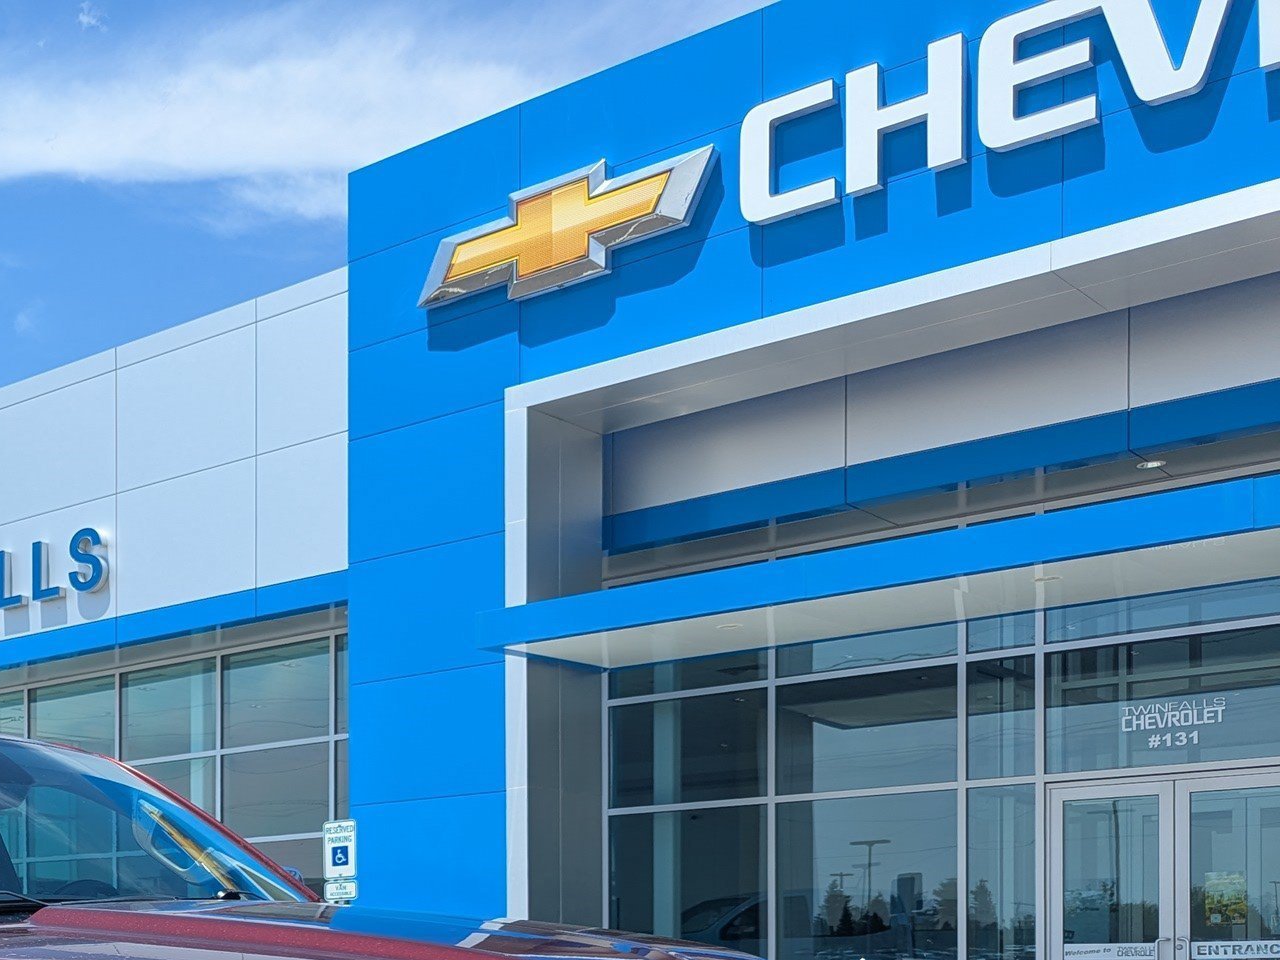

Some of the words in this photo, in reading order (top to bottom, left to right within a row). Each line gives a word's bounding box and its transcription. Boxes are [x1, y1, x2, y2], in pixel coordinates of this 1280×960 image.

[739, 0, 1280, 226] CHEV
[1121, 706, 1226, 732] CHEVROLET
[1148, 730, 1200, 749] #131
[325, 824, 355, 835] RESERVED
[327, 835, 353, 845] PARKING
[1064, 948, 1101, 957] Welcome
[1117, 949, 1155, 957] CHEVROLE
